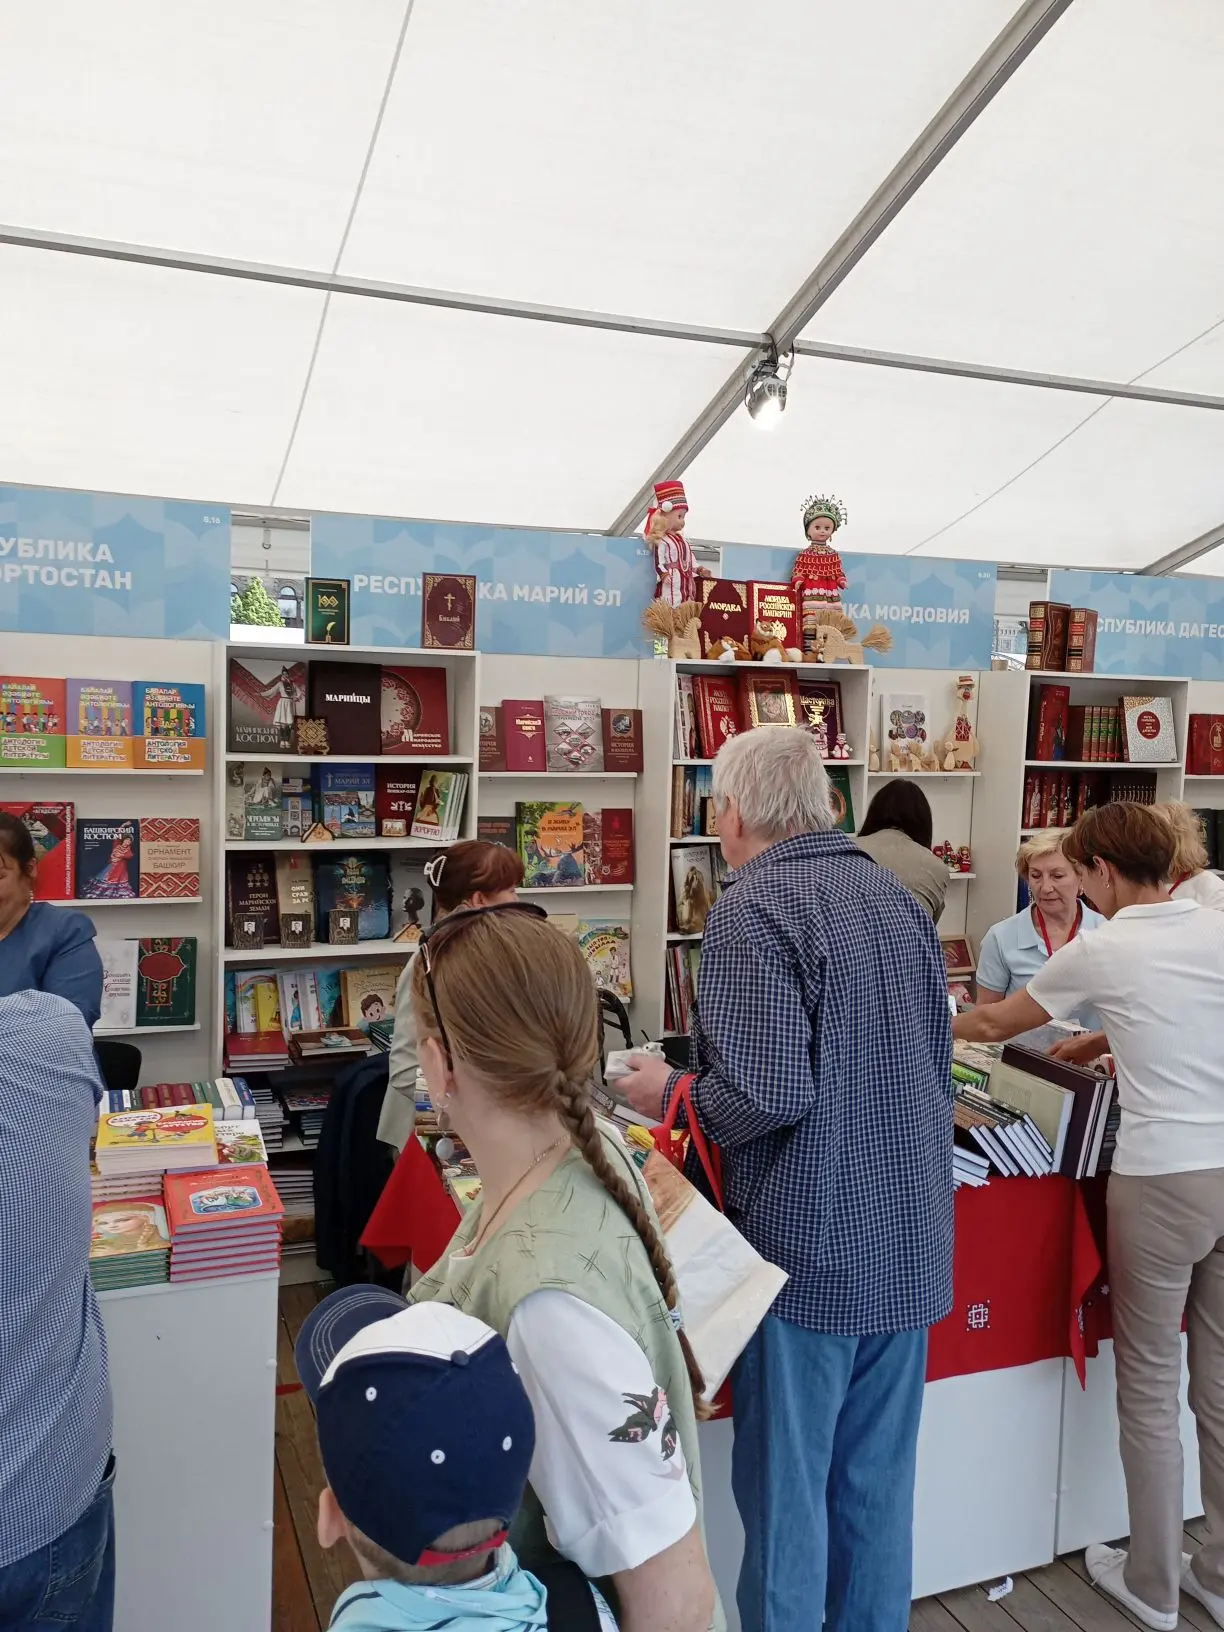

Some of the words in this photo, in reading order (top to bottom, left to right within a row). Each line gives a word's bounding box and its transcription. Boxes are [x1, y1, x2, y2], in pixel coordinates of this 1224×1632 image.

[0, 563, 131, 590] РТОСТАН
[513, 583, 588, 605] МАРИЙ
[593, 589, 621, 606] ЭЛ
[875, 605, 969, 624] МОРДОВИЯ
[325, 692, 371, 704] МАРИЙЦЫ
[83, 826, 135, 834] БАШКИРСКИЙ
[147, 848, 193, 856] ОРНАМЕНТ
